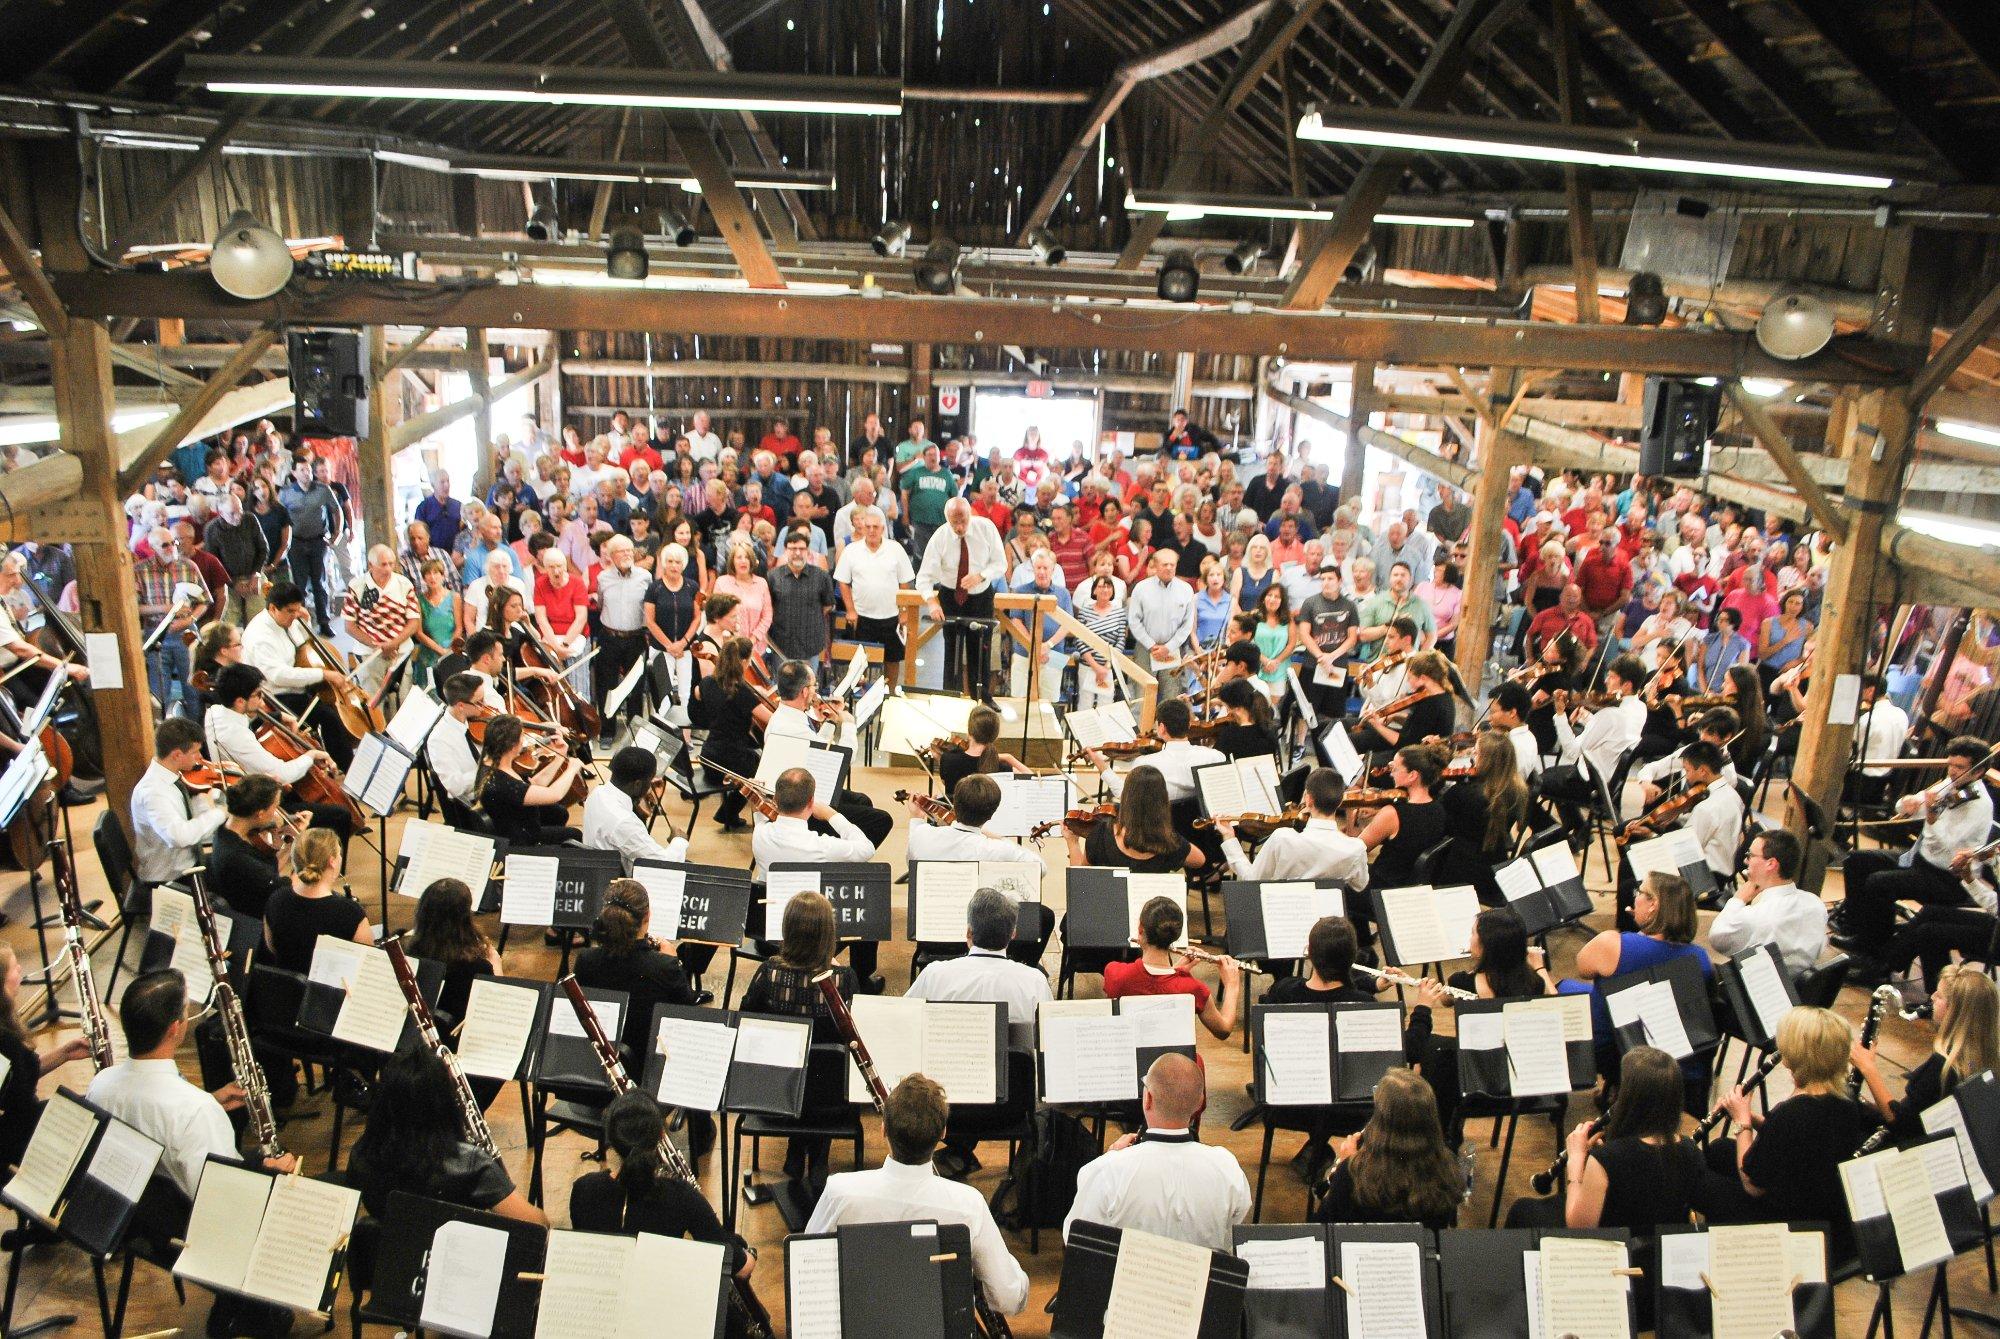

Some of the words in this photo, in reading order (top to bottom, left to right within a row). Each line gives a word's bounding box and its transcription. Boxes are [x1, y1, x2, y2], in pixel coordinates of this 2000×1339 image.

[556, 880, 585, 895] RCH
[824, 885, 866, 900] RCH
[555, 899, 584, 913] EEK
[681, 894, 710, 912] RCH
[679, 914, 708, 931] EEK
[831, 907, 866, 923] EK
